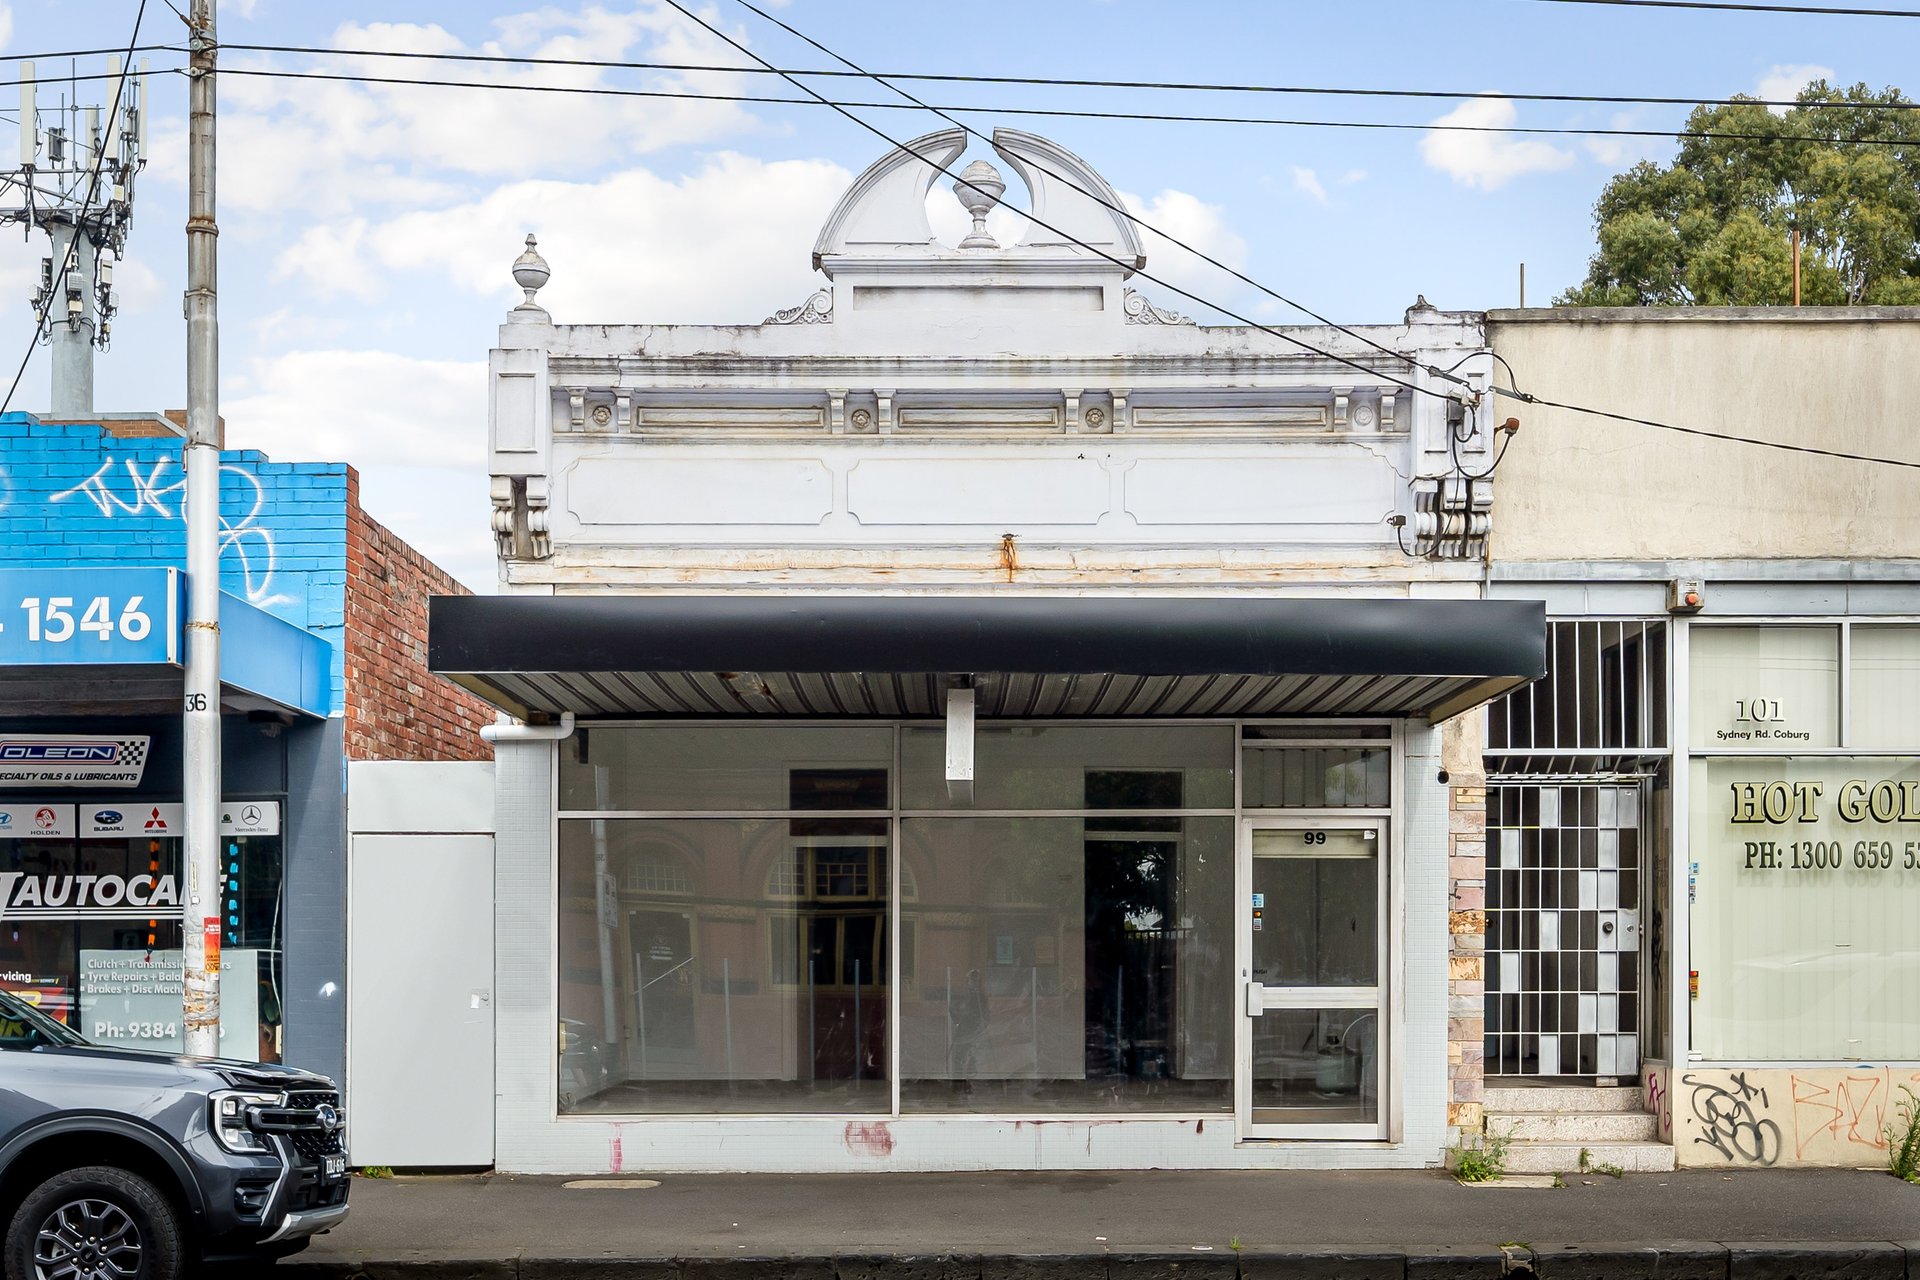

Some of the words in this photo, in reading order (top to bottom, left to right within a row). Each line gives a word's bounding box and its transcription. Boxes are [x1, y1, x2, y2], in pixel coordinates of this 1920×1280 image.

[20, 596, 152, 642] 1546
[185, 692, 207, 713] 36
[1736, 697, 1785, 722] 101
[1716, 729, 1751, 741] Sydney
[1755, 729, 1771, 739] Rd.
[1774, 729, 1810, 741] Coburg
[40, 772, 63, 780] OILS
[64, 772, 72, 780] &
[73, 773, 138, 781] LUBRICANTS
[1730, 780, 1824, 824] HOT
[1303, 831, 1327, 845] 99
[1744, 841, 1783, 869] PH:
[1790, 840, 1843, 869] 1300
[1853, 840, 1894, 869] 659
[88, 959, 117, 970] Clutch
[128, 959, 183, 970] Transmissi
[88, 972, 109, 983] Tyre
[111, 972, 148, 983] Repairs
[88, 984, 122, 994] Brakes
[132, 984, 152, 994] Disc
[94, 1021, 124, 1039] Ph:
[128, 1022, 177, 1039] 9384
